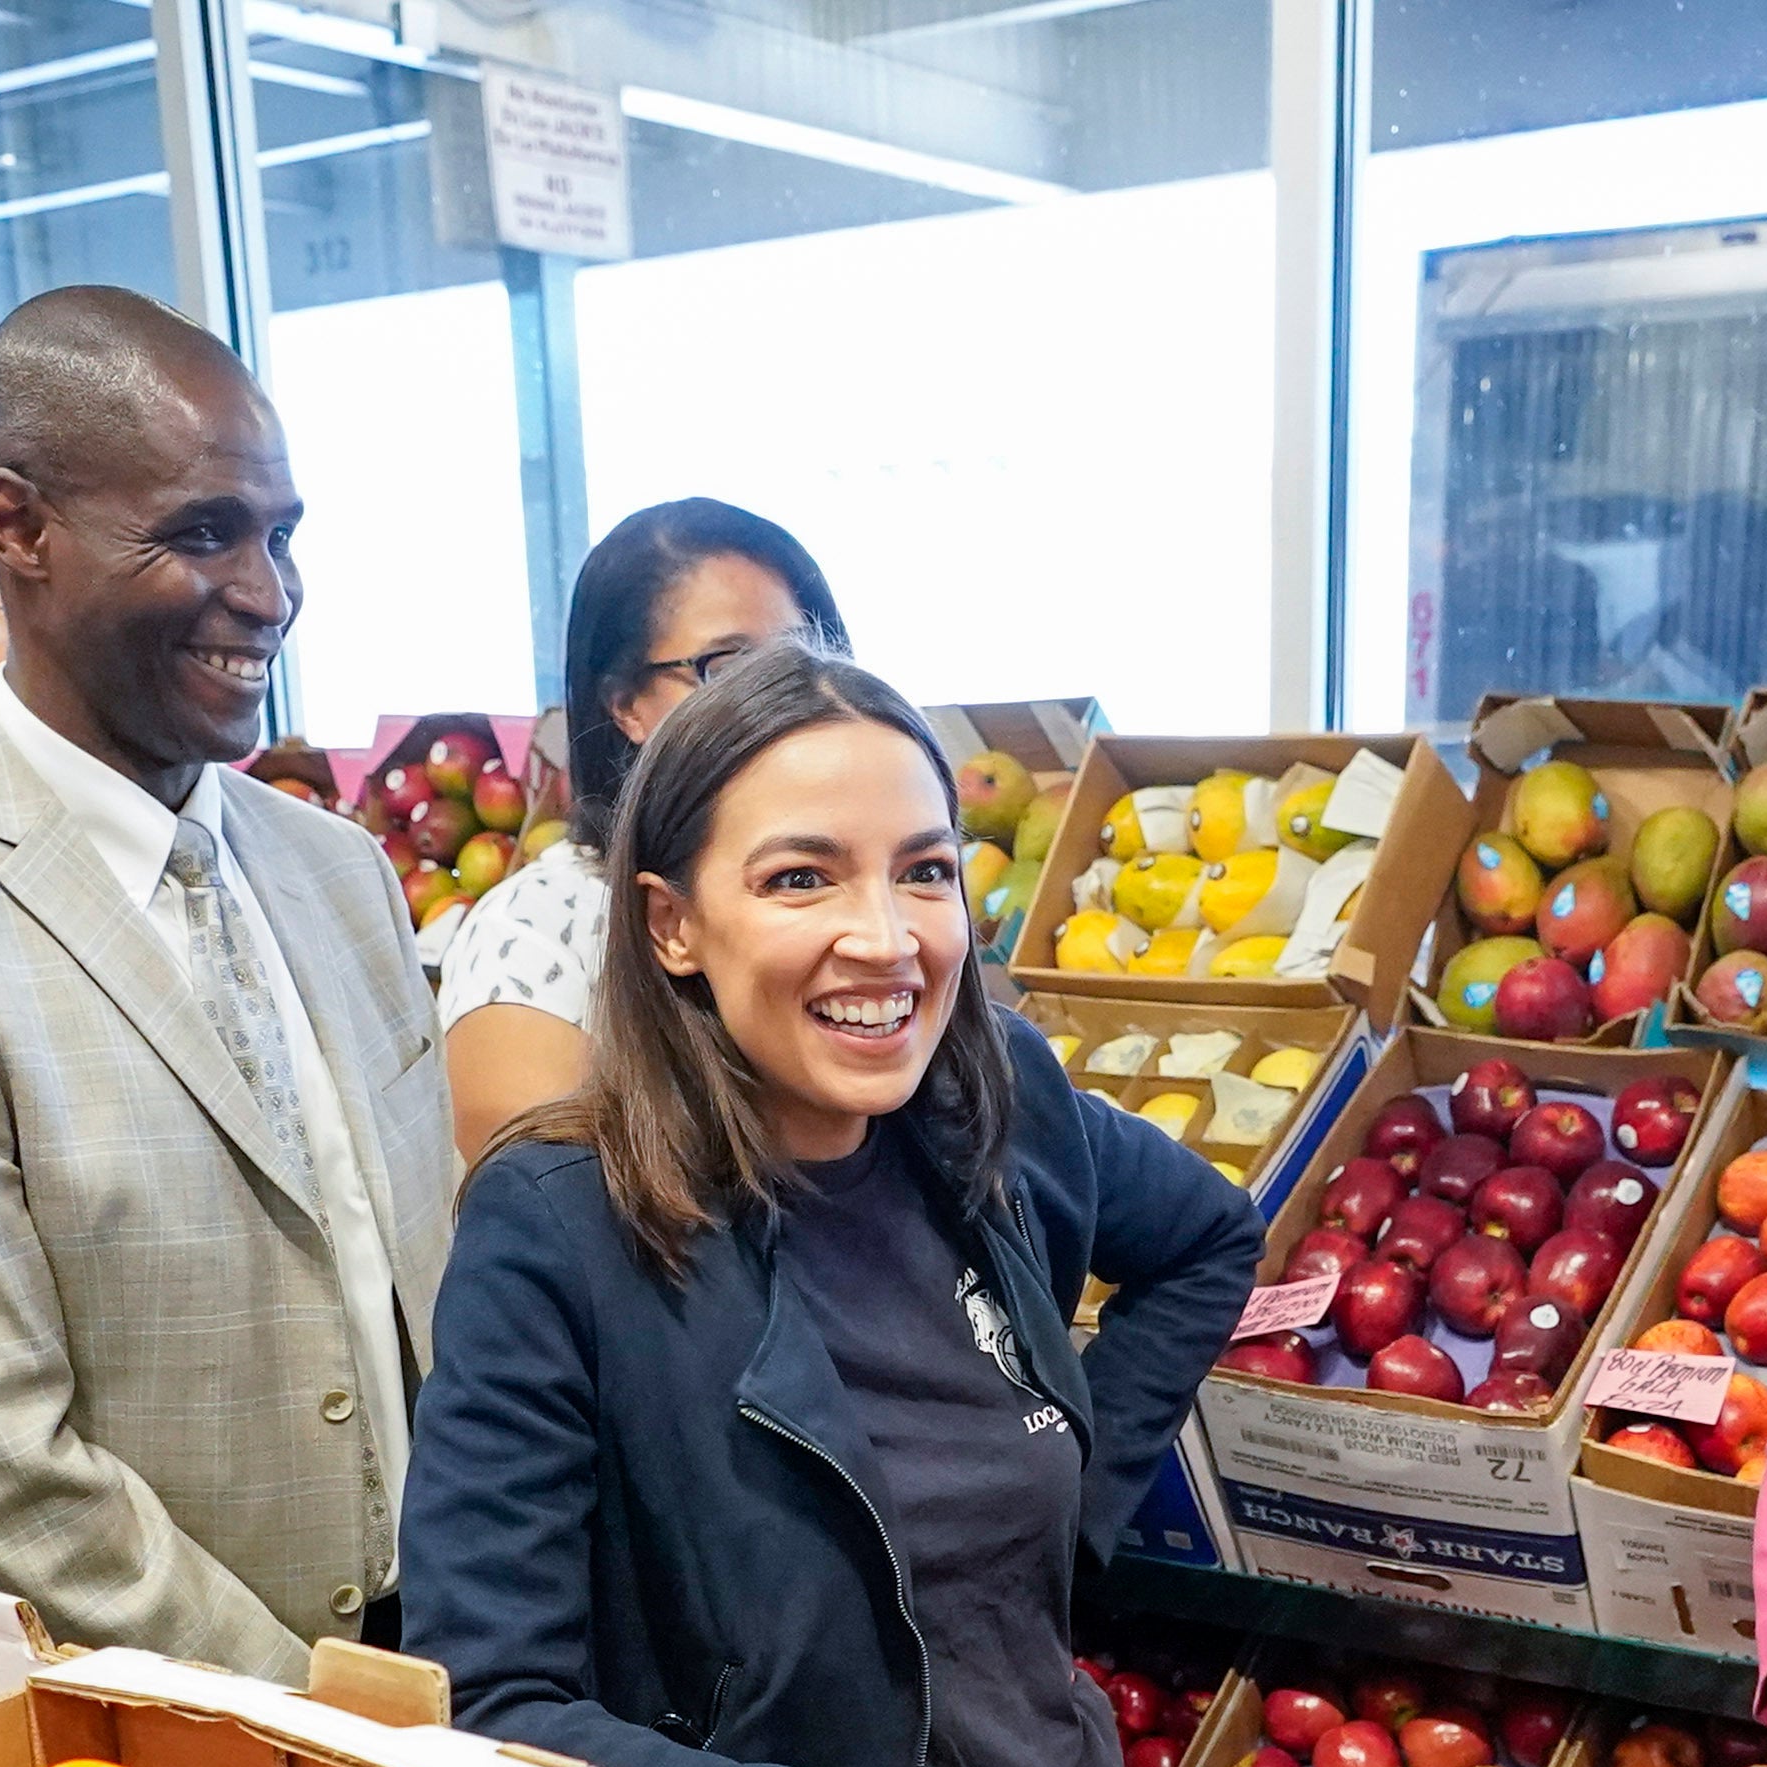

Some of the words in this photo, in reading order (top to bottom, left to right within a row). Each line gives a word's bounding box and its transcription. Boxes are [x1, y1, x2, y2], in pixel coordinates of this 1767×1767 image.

[1487, 1458, 1532, 1482] 72
[1239, 1501, 1372, 1541] RANCH
[1427, 1540, 1566, 1573] STARR
